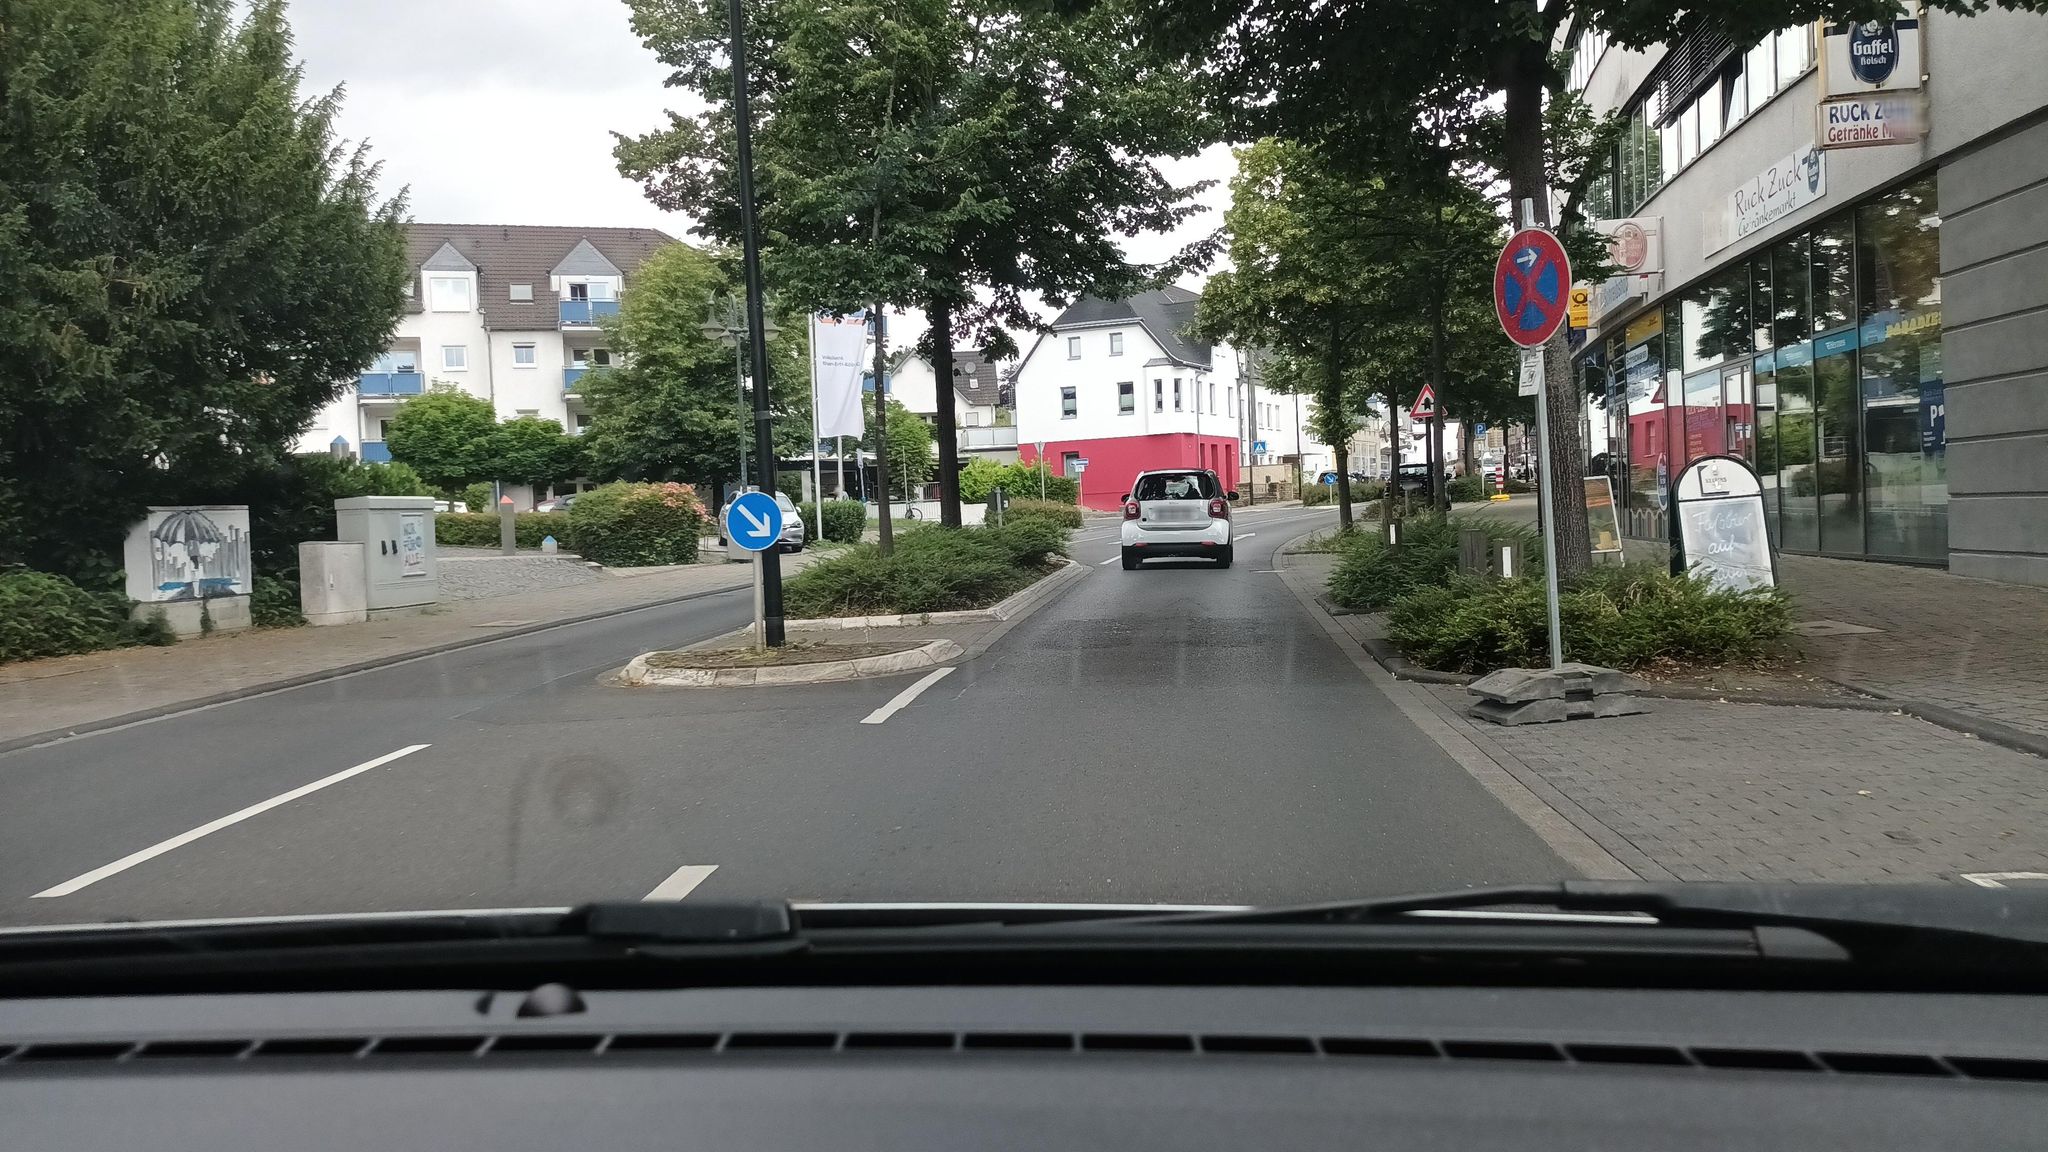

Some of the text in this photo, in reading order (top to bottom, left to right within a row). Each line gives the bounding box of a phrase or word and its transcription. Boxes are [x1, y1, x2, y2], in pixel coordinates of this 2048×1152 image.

[1853, 38, 1894, 56] Gaffel
[1829, 103, 1870, 124] RUCK
[1828, 124, 1879, 142] Getränke
[1734, 175, 1765, 218] Ruck
[1767, 153, 1802, 199] Zuck
[1738, 190, 1797, 237] Getränkemarkt
[1708, 533, 1736, 560] auf
